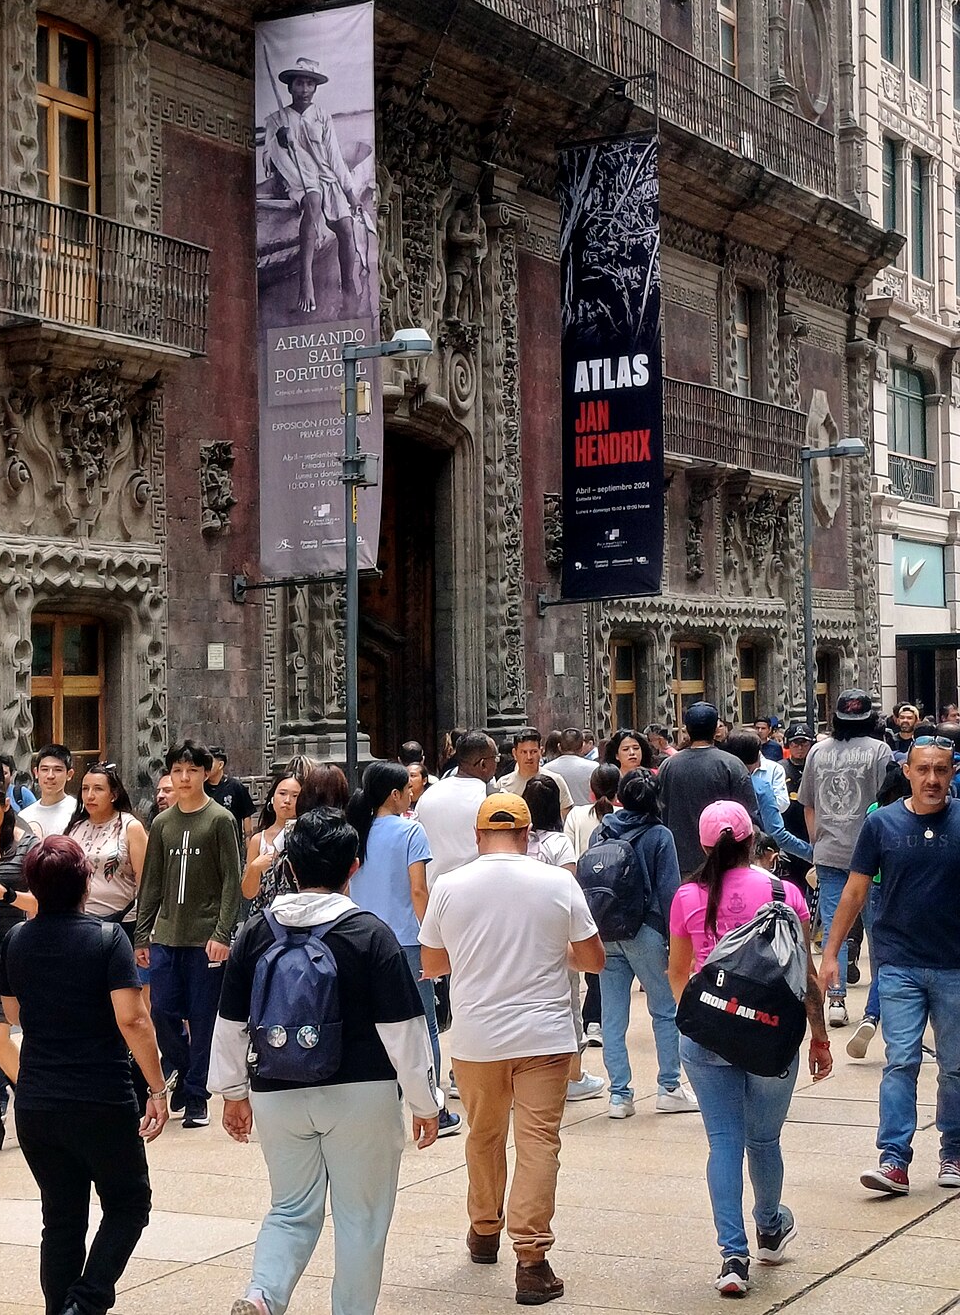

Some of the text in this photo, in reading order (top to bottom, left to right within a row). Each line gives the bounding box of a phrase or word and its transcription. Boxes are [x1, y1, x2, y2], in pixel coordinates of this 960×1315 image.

[274, 328, 366, 351] ARMANDO
[308, 345, 366, 364] SAL
[274, 361, 367, 384] PORTUGL
[574, 353, 650, 393] ATLAS
[271, 416, 371, 432] EXPOSICIÓN FOTOGICA
[575, 400, 610, 434] JAN
[300, 428, 343, 439] PRIMER PISO
[575, 429, 651, 468] HENDRIX
[576, 487, 591, 495] Abril
[597, 483, 632, 494] septiembre
[633, 481, 650, 490] 2024
[169, 847, 201, 856] PARIS
